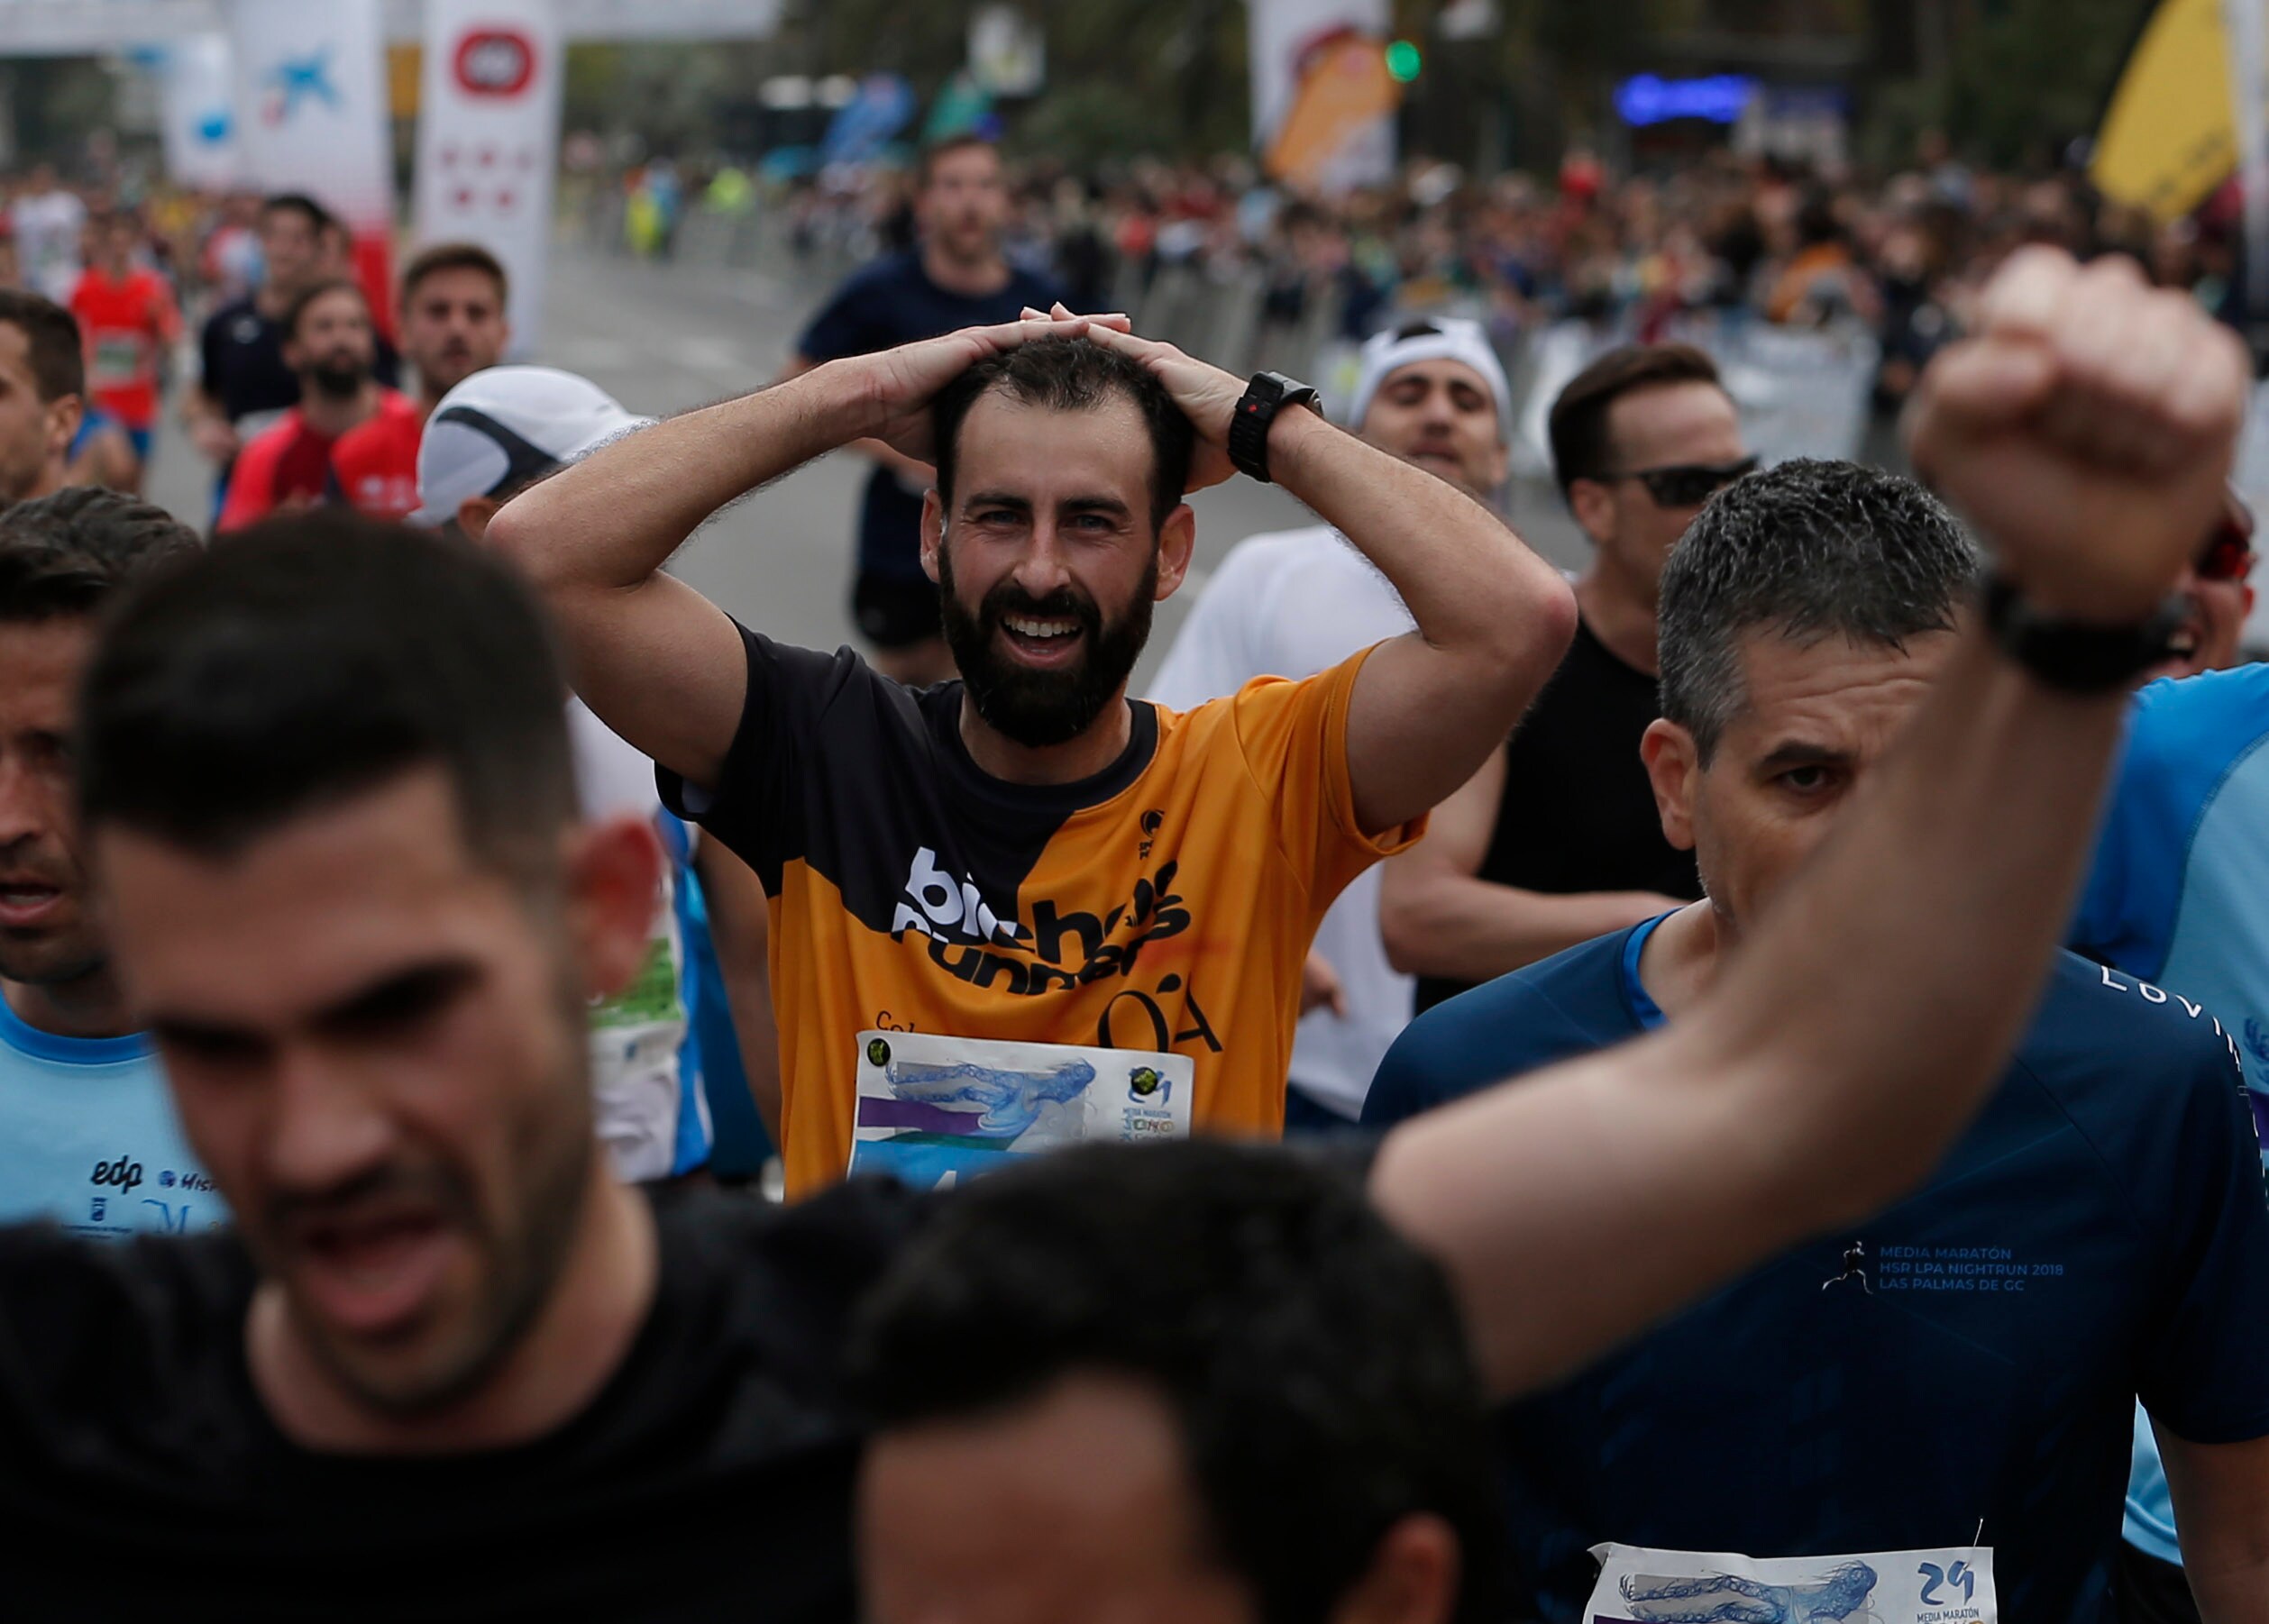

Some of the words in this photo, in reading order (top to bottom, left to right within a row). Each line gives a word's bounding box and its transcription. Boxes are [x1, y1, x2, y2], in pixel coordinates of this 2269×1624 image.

[91, 1154, 142, 1195] edp
[1880, 1245, 1930, 1259] MEDIA
[1935, 1245, 2012, 1260] MARATÓN
[1880, 1262, 1911, 1274] HSR
[1915, 1263, 1944, 1275] LPA
[1948, 1263, 2028, 1276] NIGHTRUN
[2032, 1264, 2064, 1276] 2018
[1879, 1277, 1908, 1290] LAS
[1912, 1277, 1975, 1291] PALMAS
[1979, 1279, 2000, 1291] DE
[2004, 1279, 2025, 1291] GC
[1917, 1560, 1975, 1606] 29
[1917, 1611, 1942, 1623] MEDIA
[1943, 1607, 1980, 1620] MARATÓN
